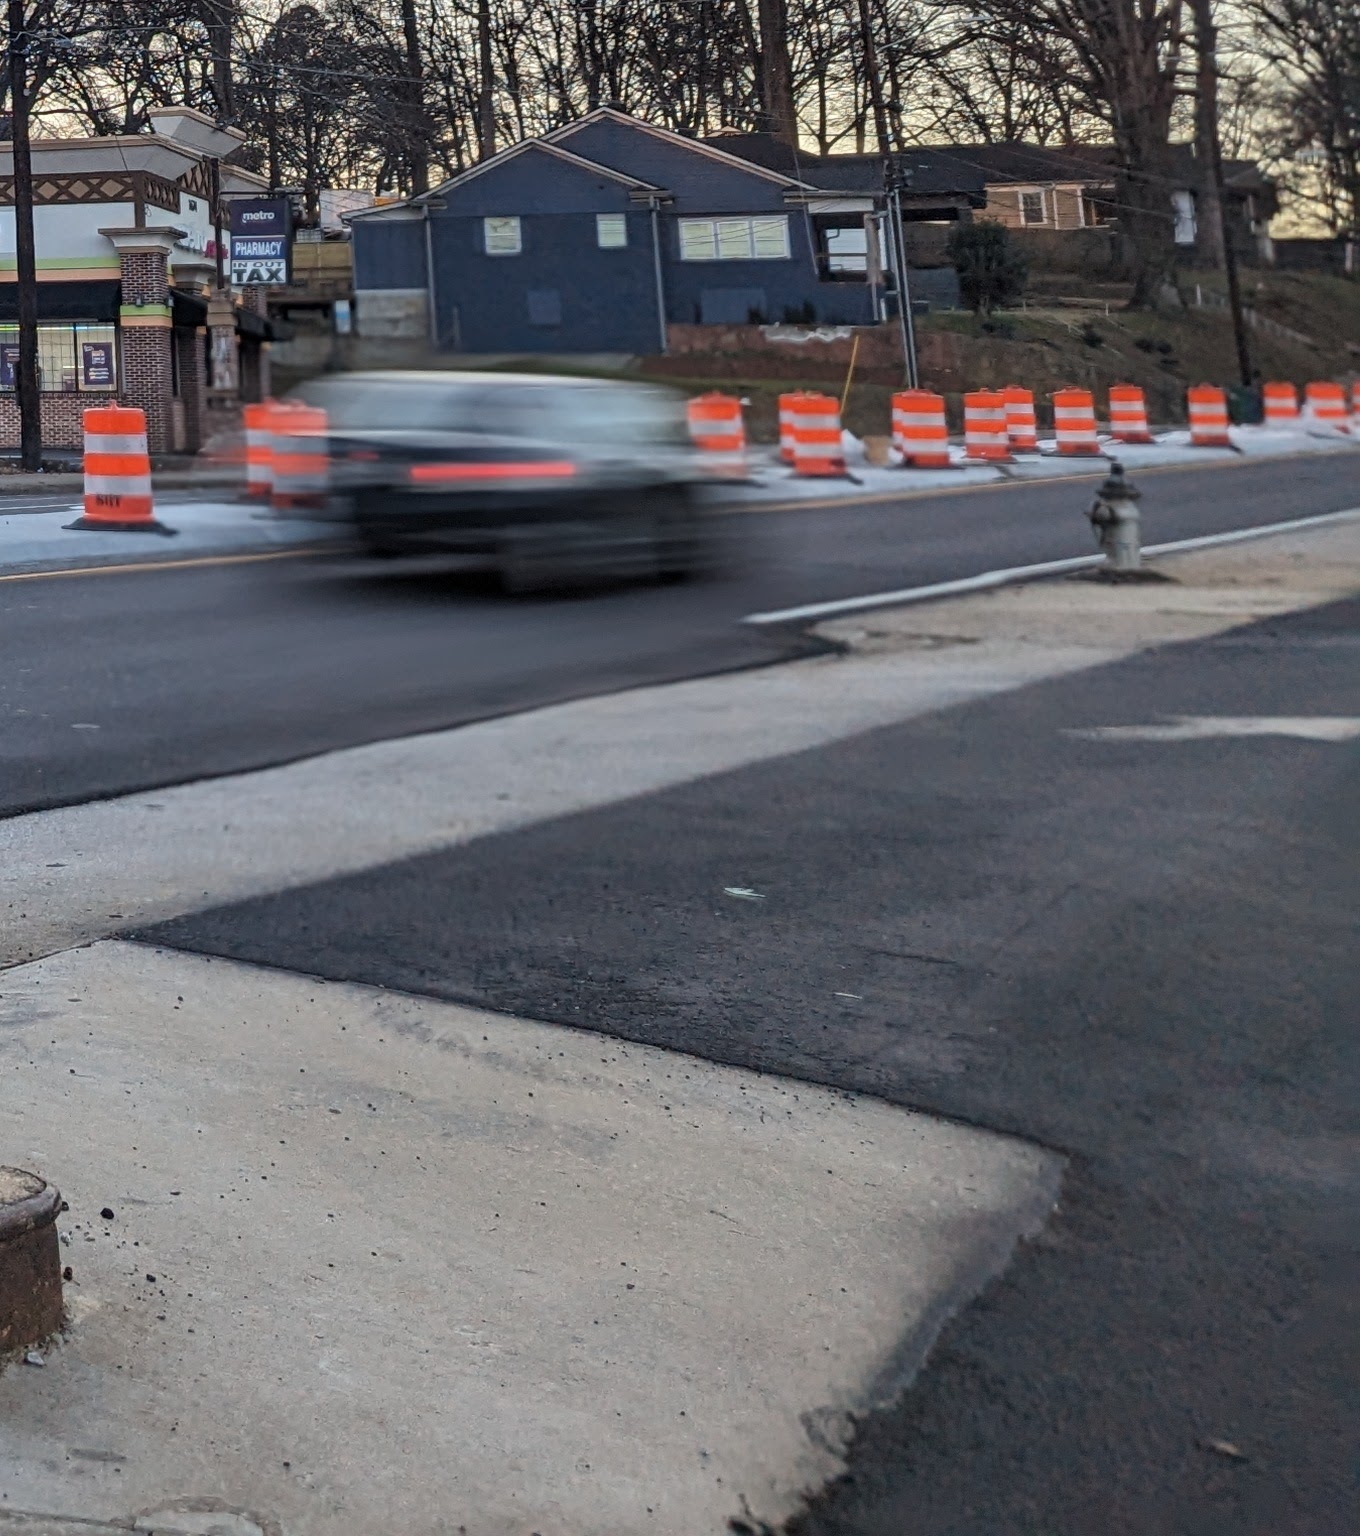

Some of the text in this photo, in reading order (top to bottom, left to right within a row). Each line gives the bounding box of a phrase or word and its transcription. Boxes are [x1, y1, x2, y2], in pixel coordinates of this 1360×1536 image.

[242, 210, 275, 223] metro
[235, 241, 282, 256] PHARMACY
[233, 268, 284, 282] TAX
